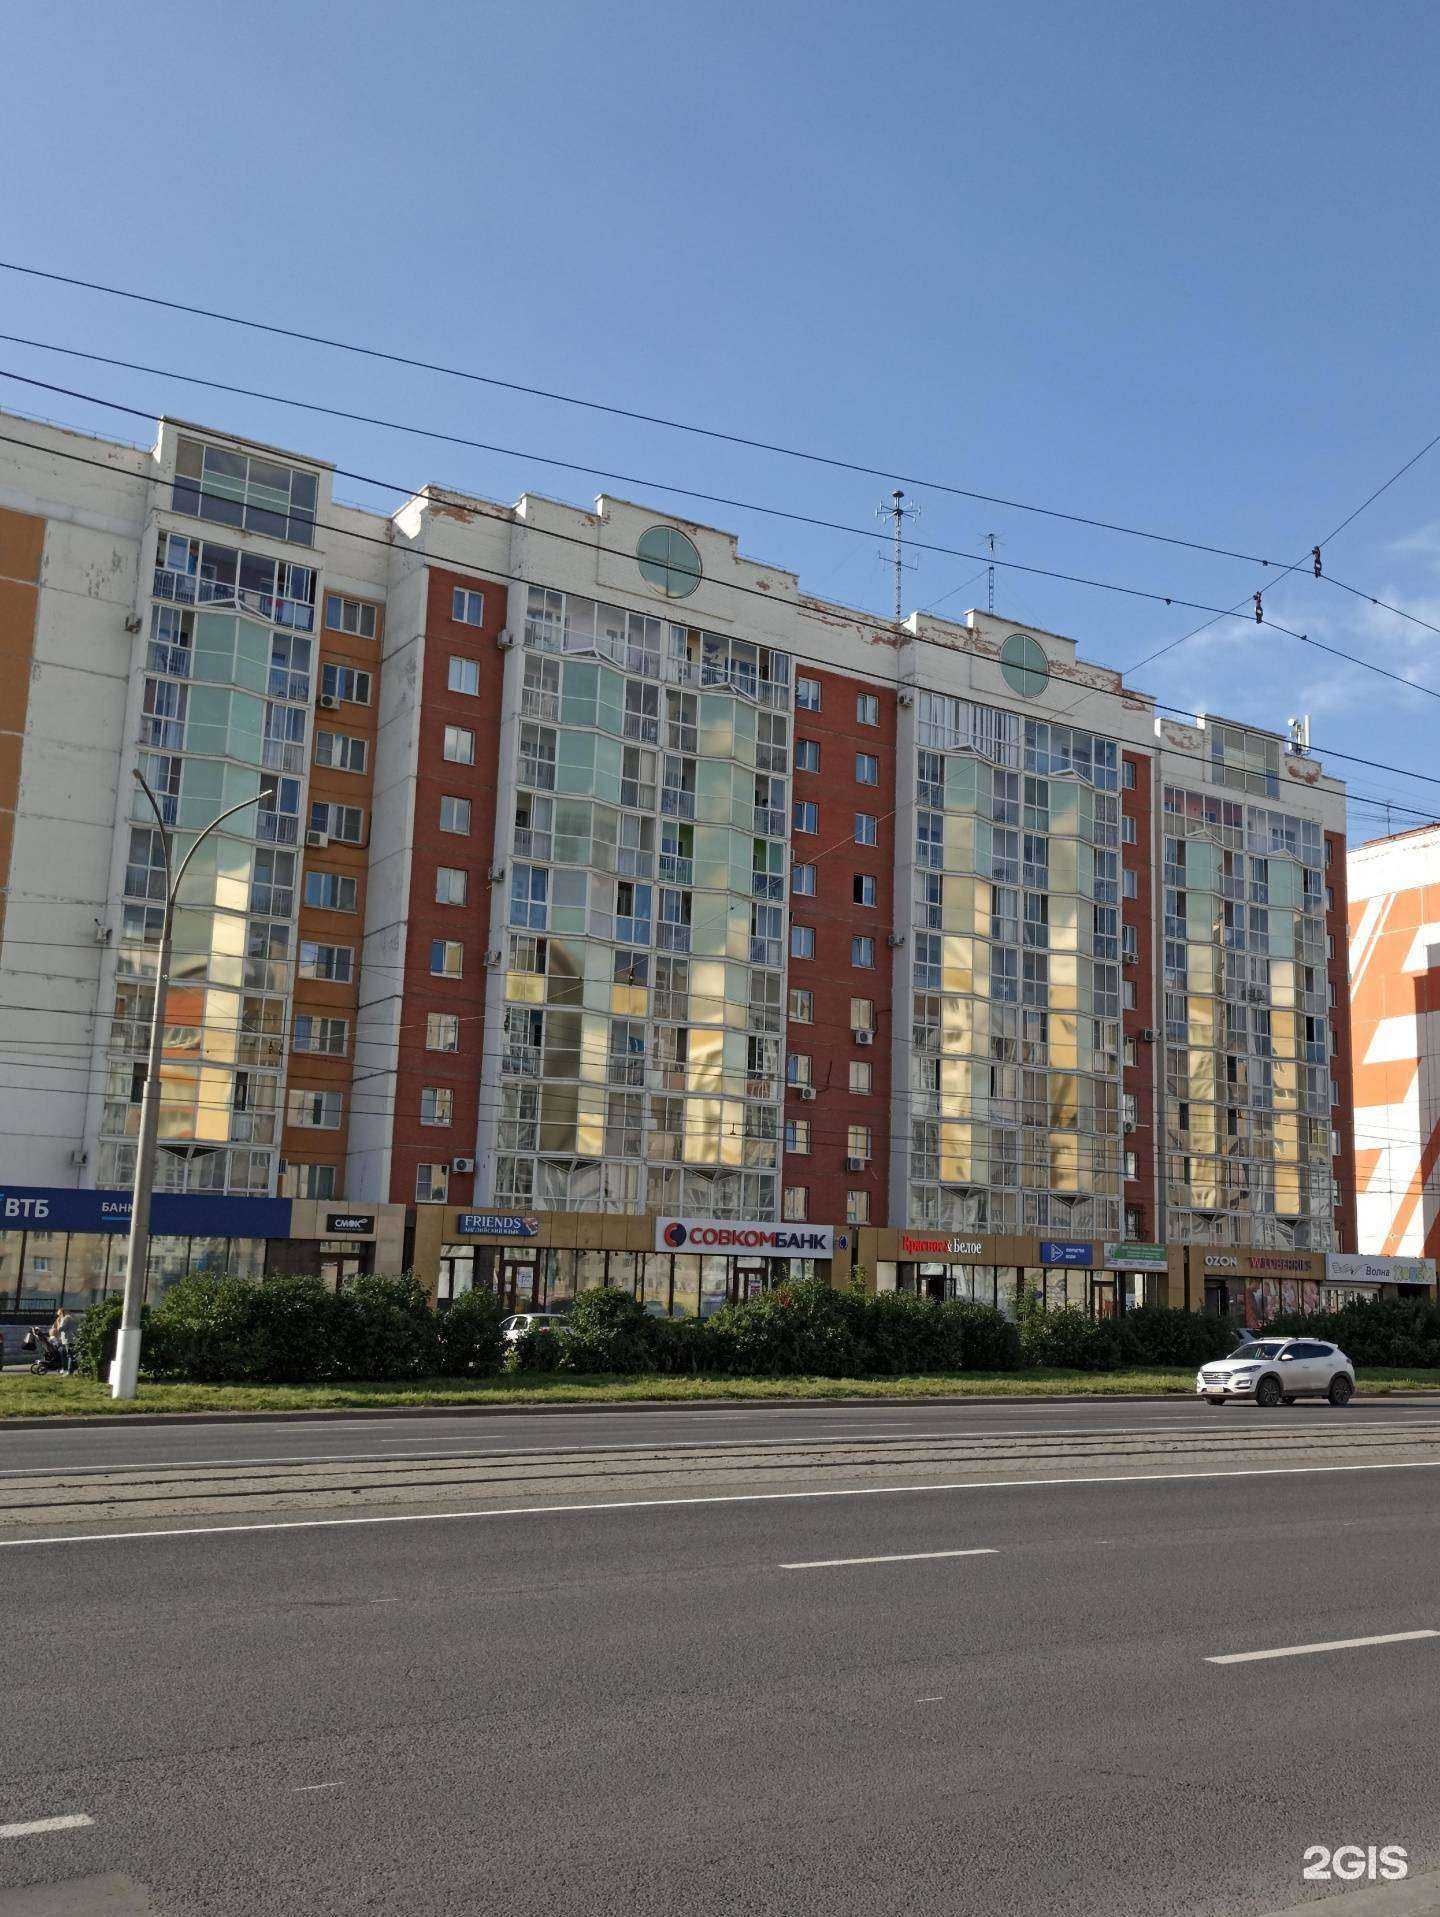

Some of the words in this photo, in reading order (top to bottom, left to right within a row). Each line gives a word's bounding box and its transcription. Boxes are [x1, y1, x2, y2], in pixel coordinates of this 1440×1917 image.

[5, 1198, 49, 1217] ВТБ
[465, 1215, 521, 1228] FRIENDS
[690, 1227, 826, 1249] СОВКОМБАНК
[1205, 1255, 1237, 1267] OZON
[1366, 1266, 1390, 1277] Волна
